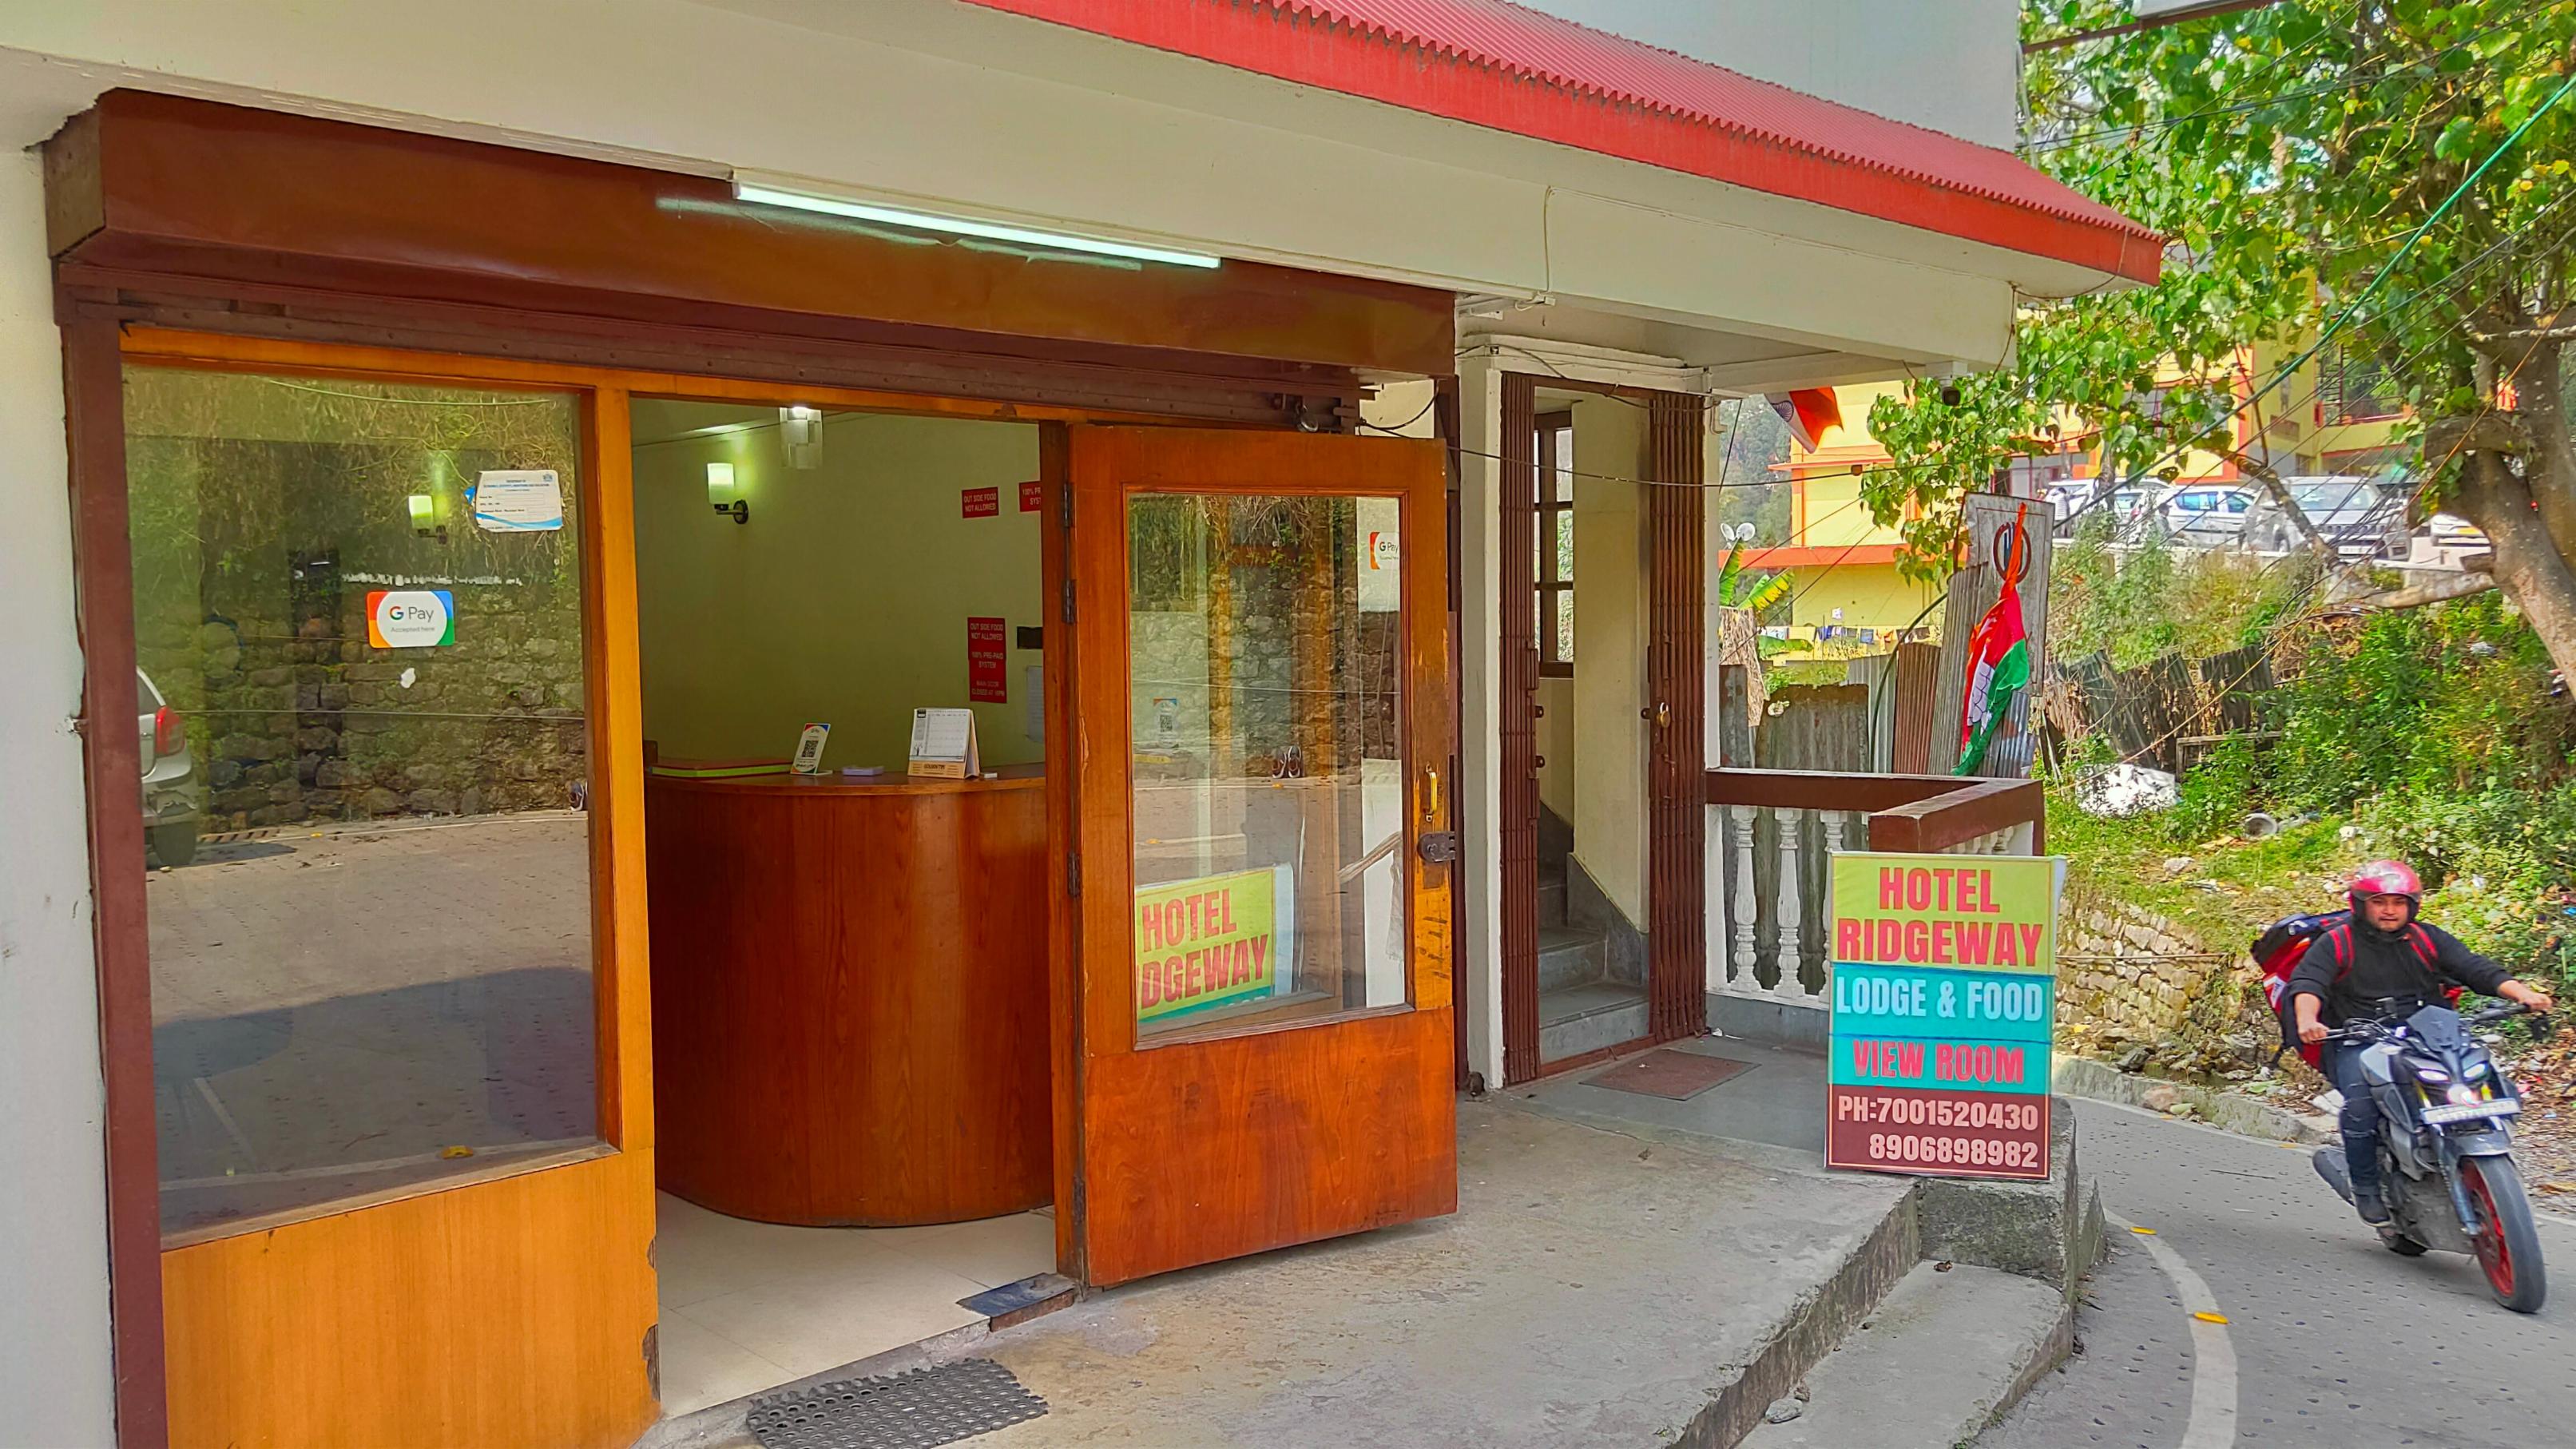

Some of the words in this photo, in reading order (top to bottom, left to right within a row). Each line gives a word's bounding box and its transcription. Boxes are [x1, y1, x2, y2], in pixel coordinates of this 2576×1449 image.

[974, 502, 996, 511] ALLOWED
[1387, 542, 1398, 554] Pay
[408, 606, 435, 622] Pay
[1879, 867, 2000, 913] HOTEL
[1141, 887, 1237, 953] HOTEL
[1837, 918, 2043, 967] RIDGEWAY
[1836, 975, 1927, 1018] LODGE
[1936, 979, 1958, 1019] &
[1967, 981, 2044, 1022] FOOD
[1852, 1040, 1925, 1078] VIEW
[1935, 1044, 2024, 1084] ROOM
[1838, 1095, 2038, 1131] PH:7001520430
[1869, 1133, 2038, 1168] 8906898982
